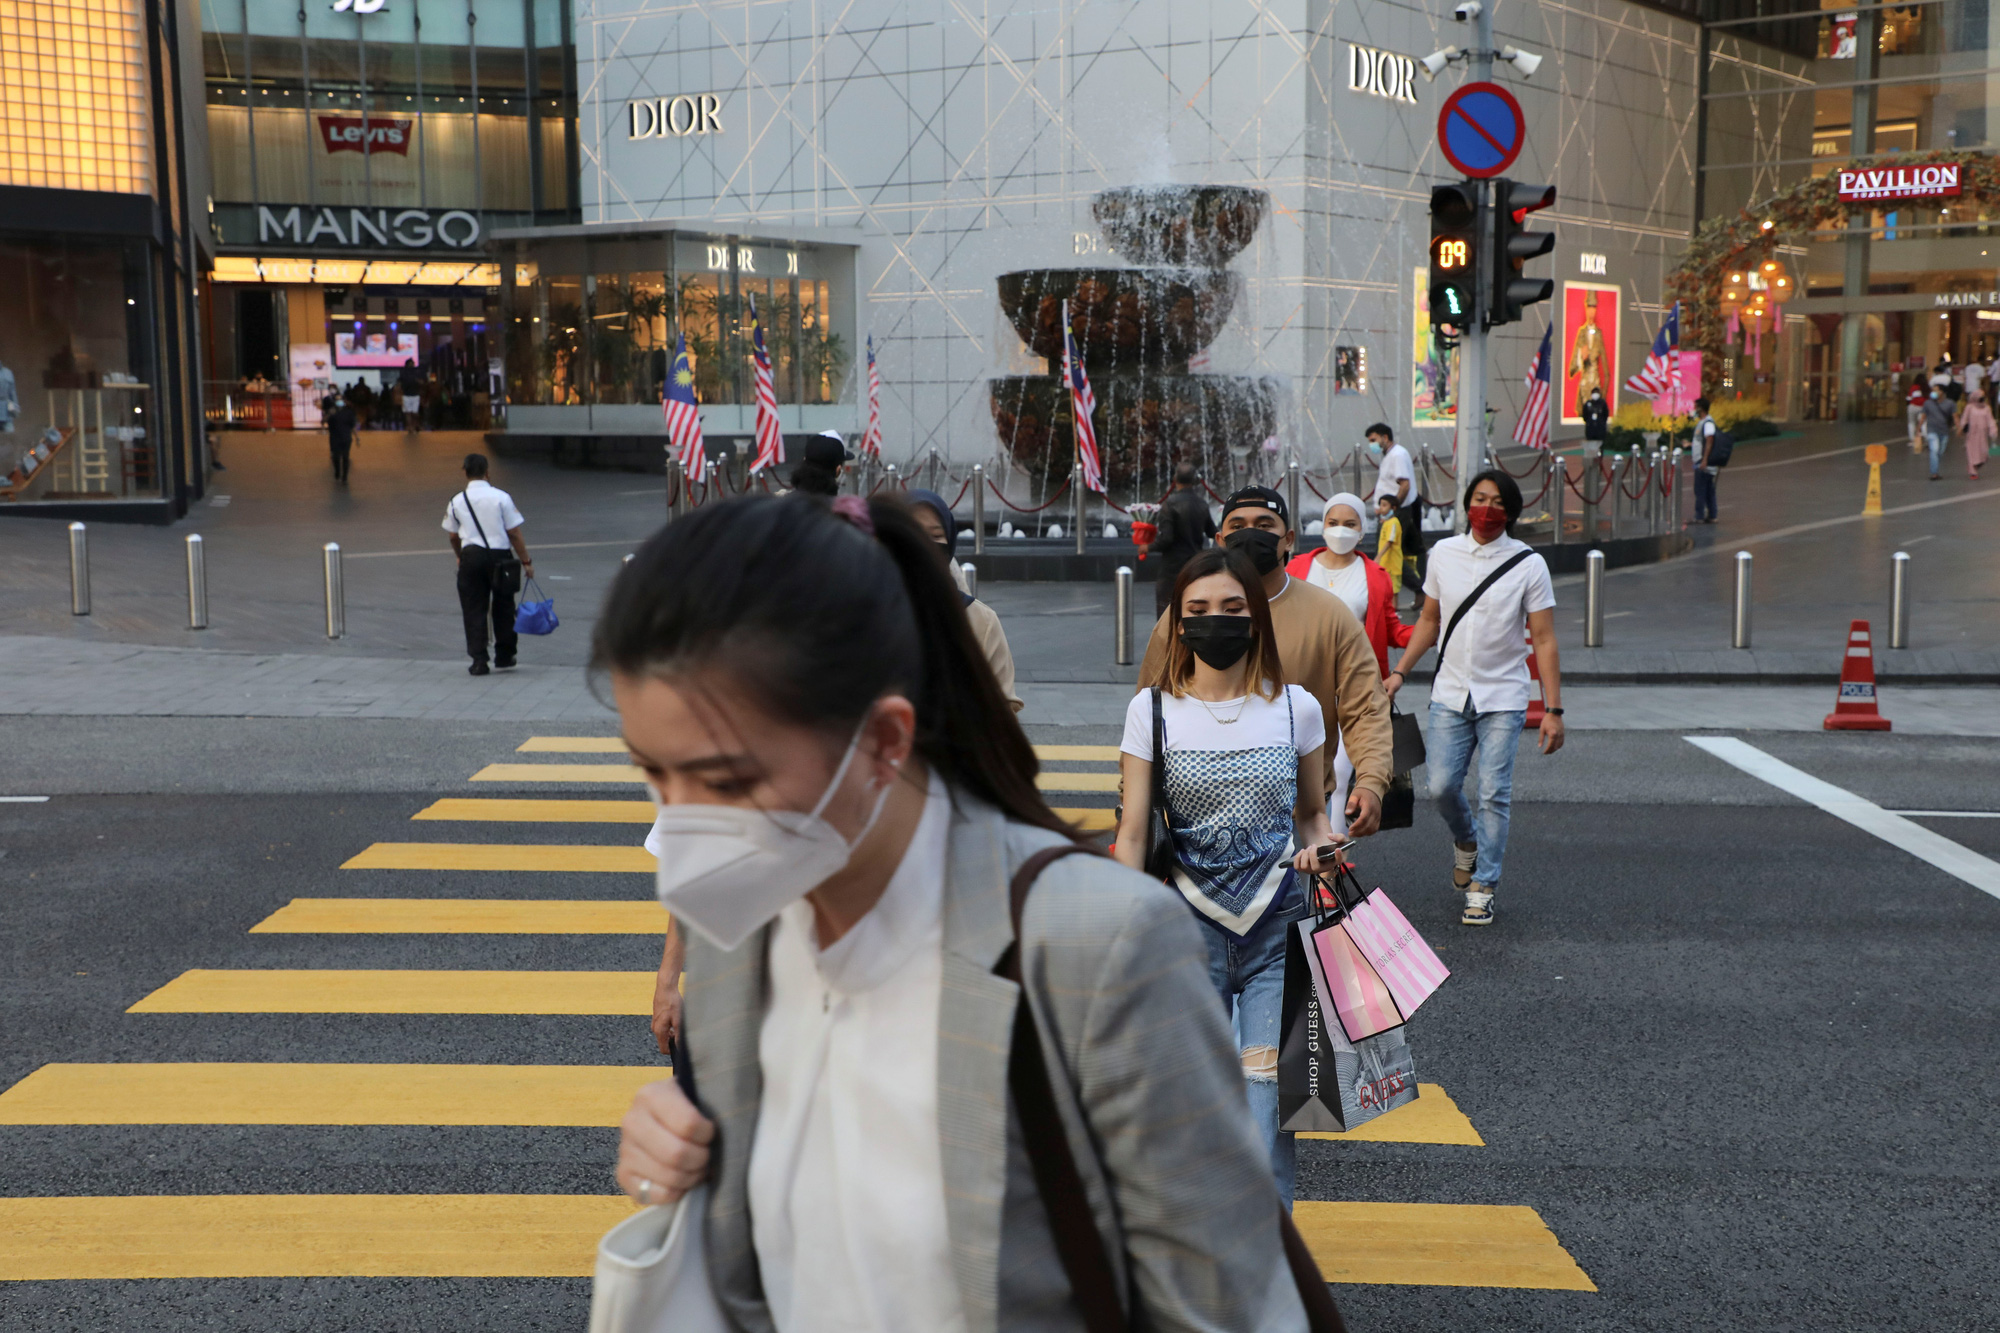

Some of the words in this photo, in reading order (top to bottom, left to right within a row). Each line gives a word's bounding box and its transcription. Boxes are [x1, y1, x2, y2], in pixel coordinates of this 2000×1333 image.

[1348, 43, 1418, 104] DIOR
[628, 94, 724, 140] DIOR
[1840, 166, 1958, 191] PAVILION
[259, 206, 480, 247] MANGO
[1440, 241, 1466, 268] 09
[252, 262, 350, 280] WELCOME
[364, 264, 391, 280] TO
[1935, 292, 1981, 306] MAIN
[1989, 291, 2000, 305] E
[1841, 685, 1874, 697] POLIS
[1393, 928, 1416, 952] SECRET
[1309, 1057, 1319, 1097] SHOP
[1360, 1071, 1405, 1109] GUESS
